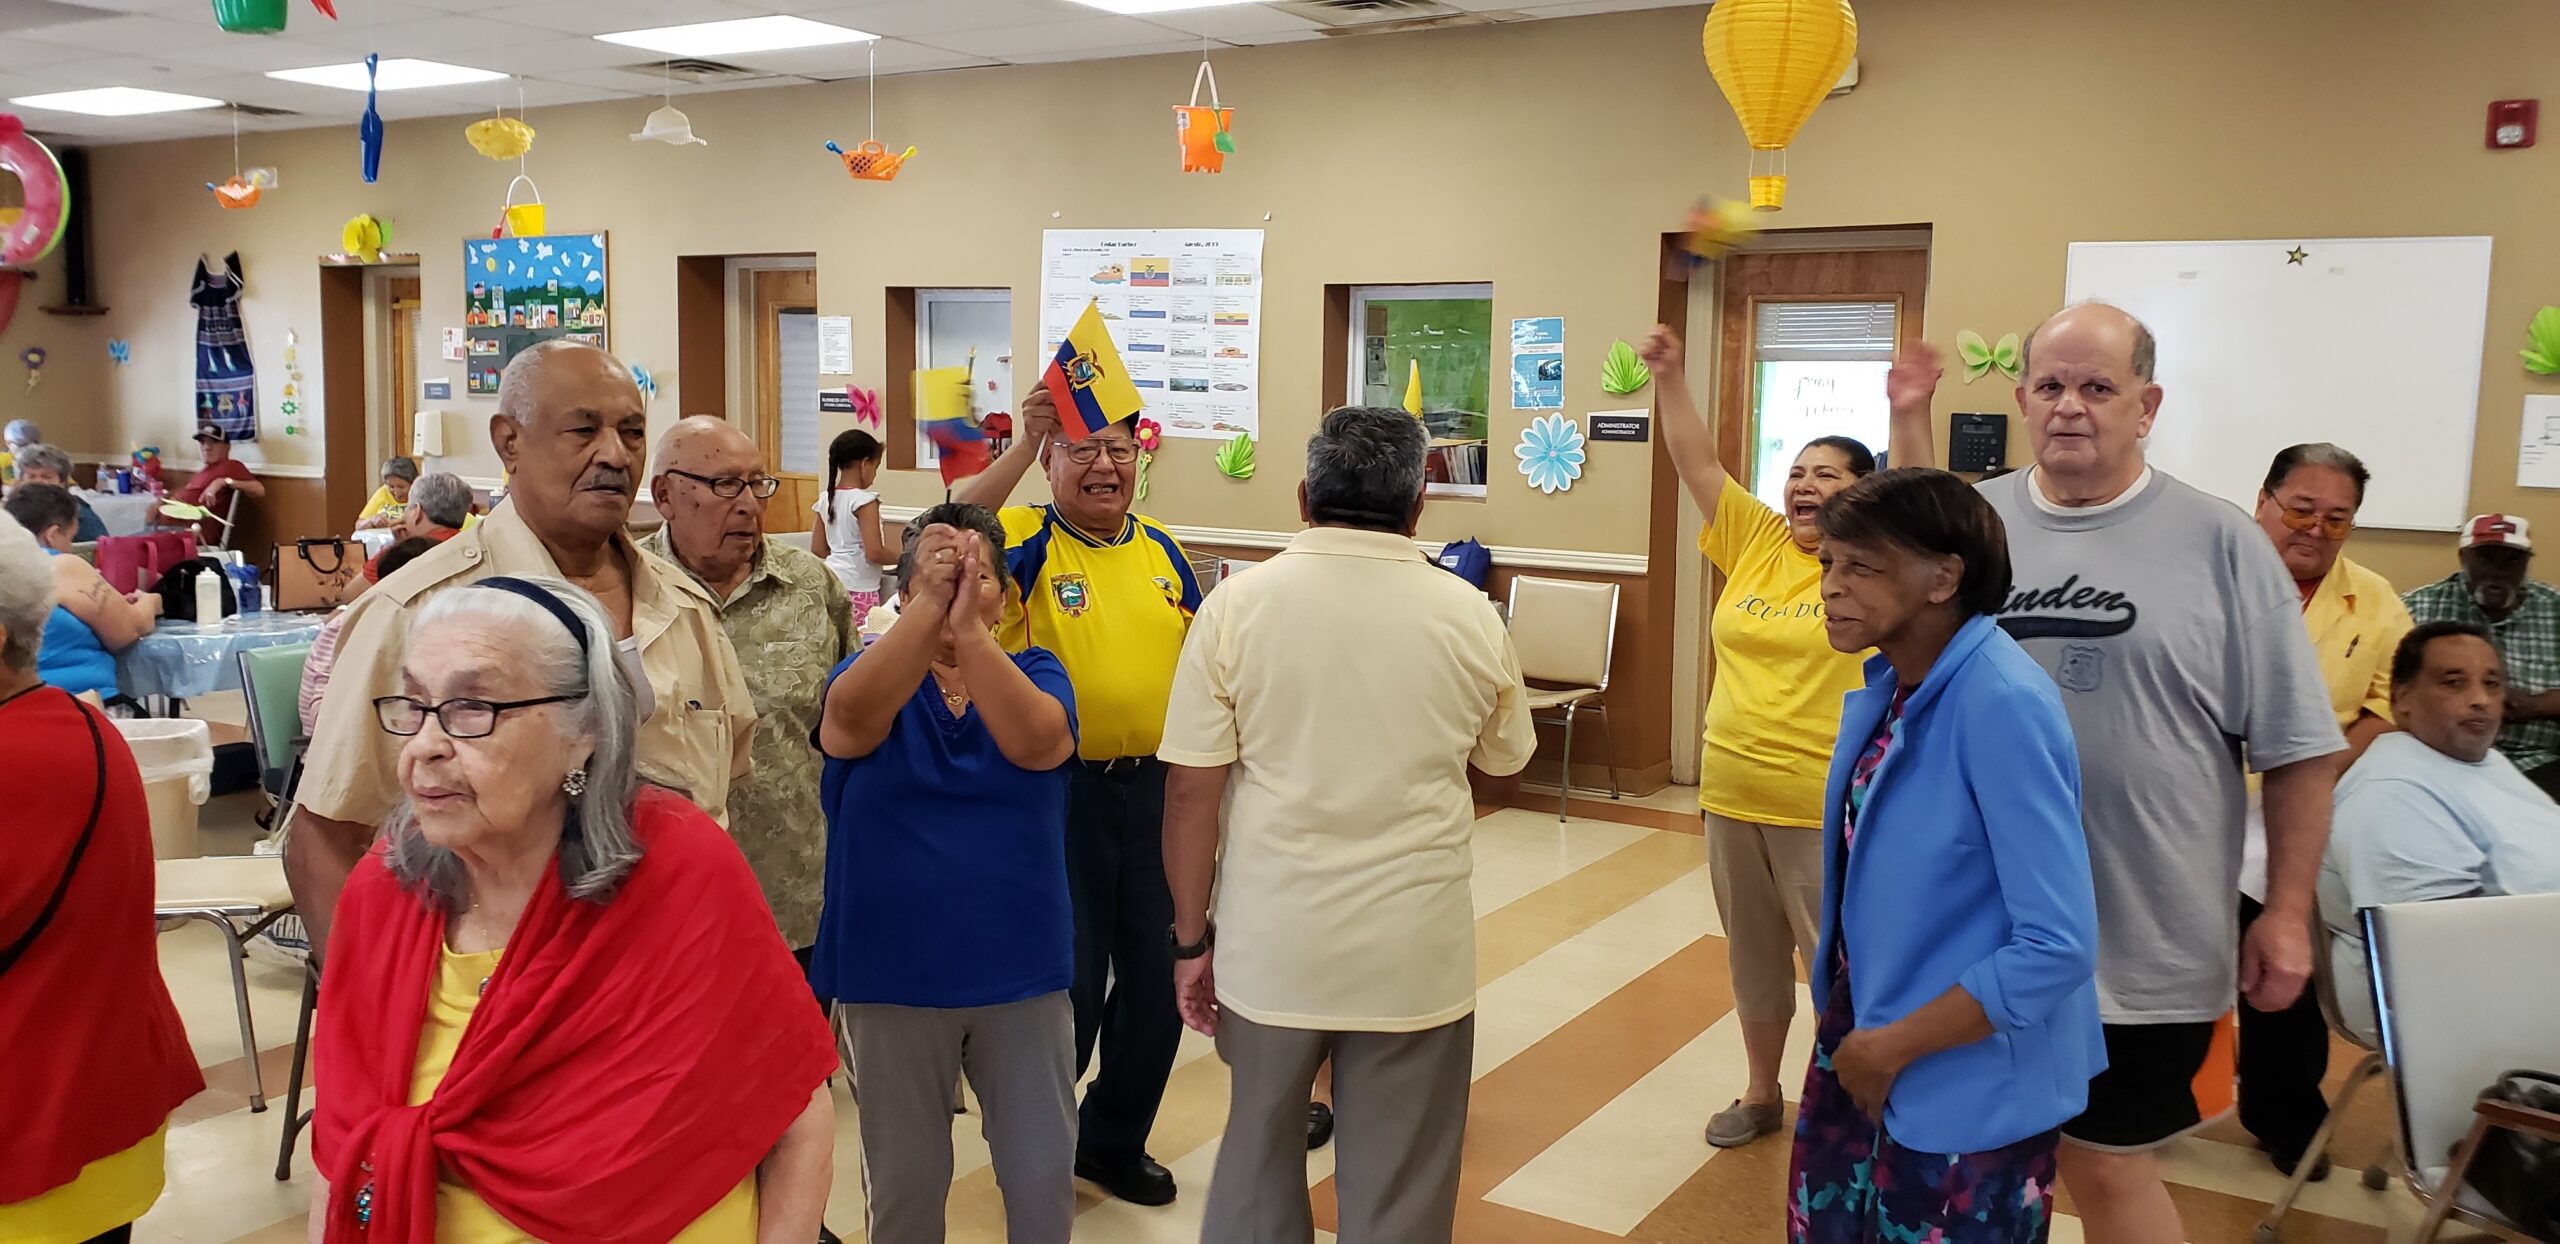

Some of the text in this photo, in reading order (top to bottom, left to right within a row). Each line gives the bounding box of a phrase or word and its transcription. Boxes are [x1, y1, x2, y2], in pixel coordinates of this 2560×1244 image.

[1596, 422, 1640, 430] ADMINISTRATOR
[1735, 594, 1826, 622] ECUADO
[2000, 573, 2136, 616] inden
